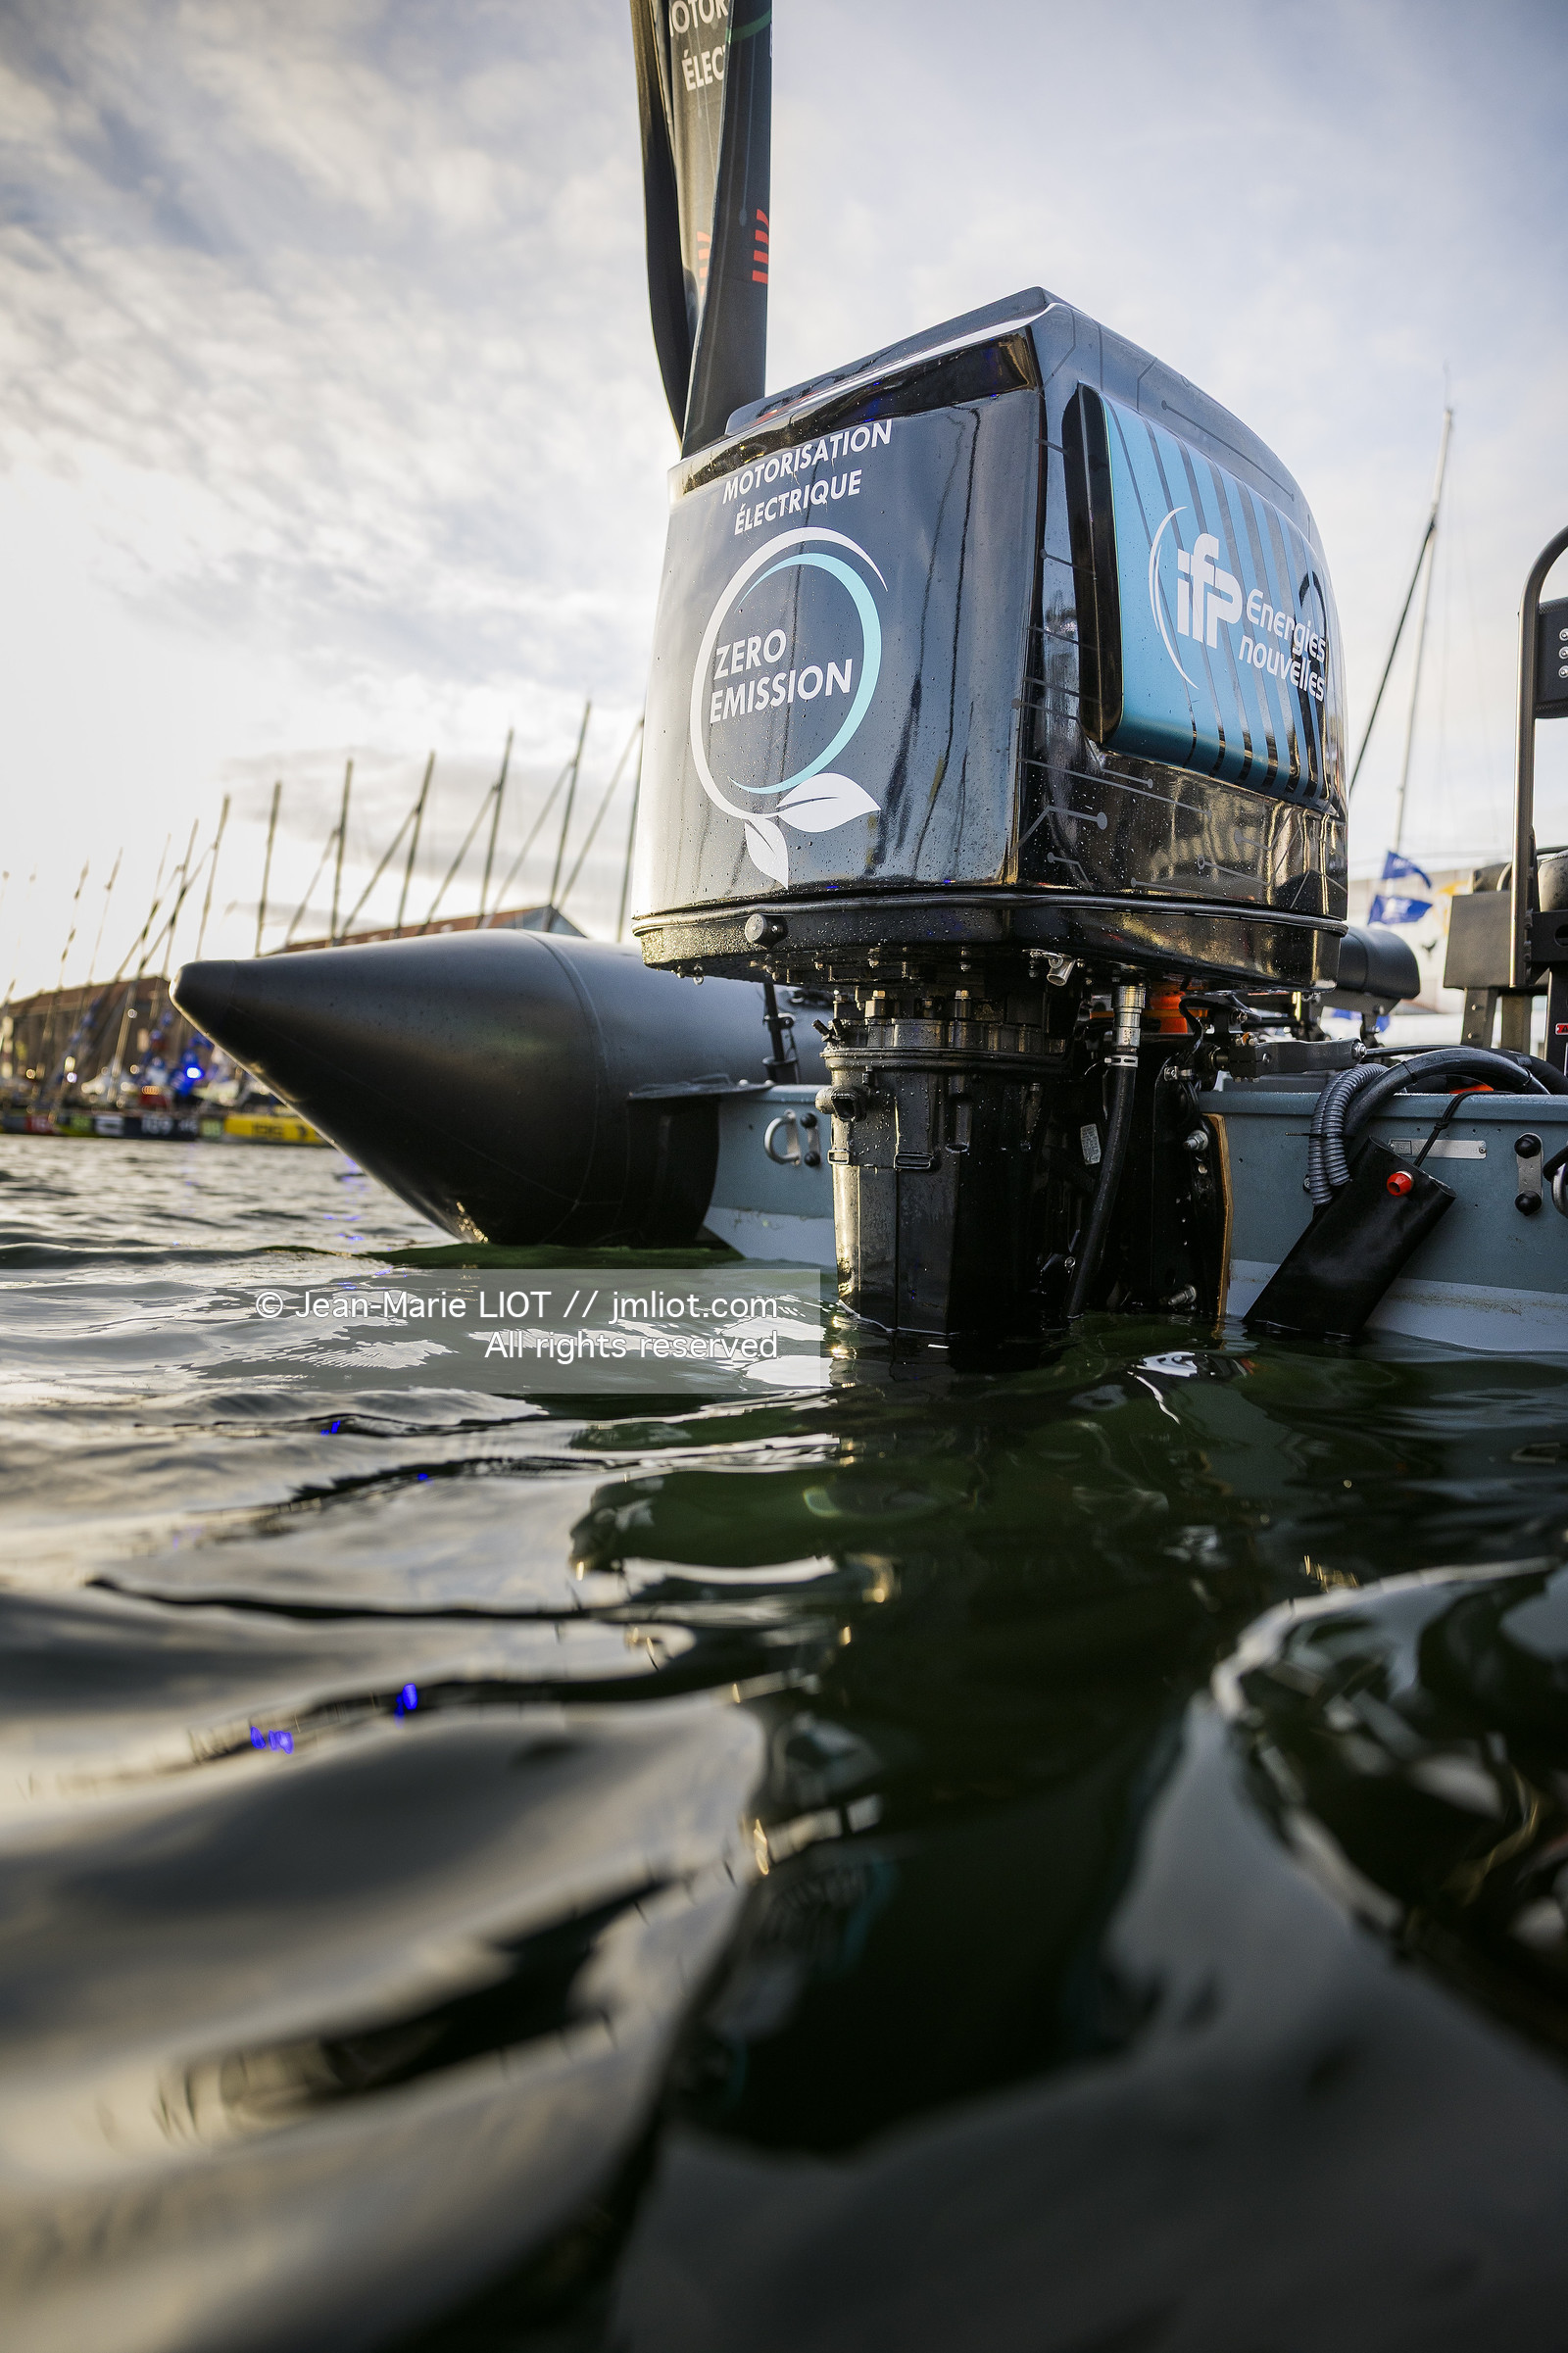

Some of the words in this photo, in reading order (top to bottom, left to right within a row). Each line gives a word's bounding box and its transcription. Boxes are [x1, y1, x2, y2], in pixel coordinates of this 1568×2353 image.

[722, 418, 893, 505] MOTORISATION
[734, 468, 862, 535] ÉLECTRIQUE
[713, 628, 787, 680] ZERO
[1246, 588, 1327, 663] Energies
[710, 659, 853, 724] EMISSION
[1238, 634, 1325, 702] nouvelles
